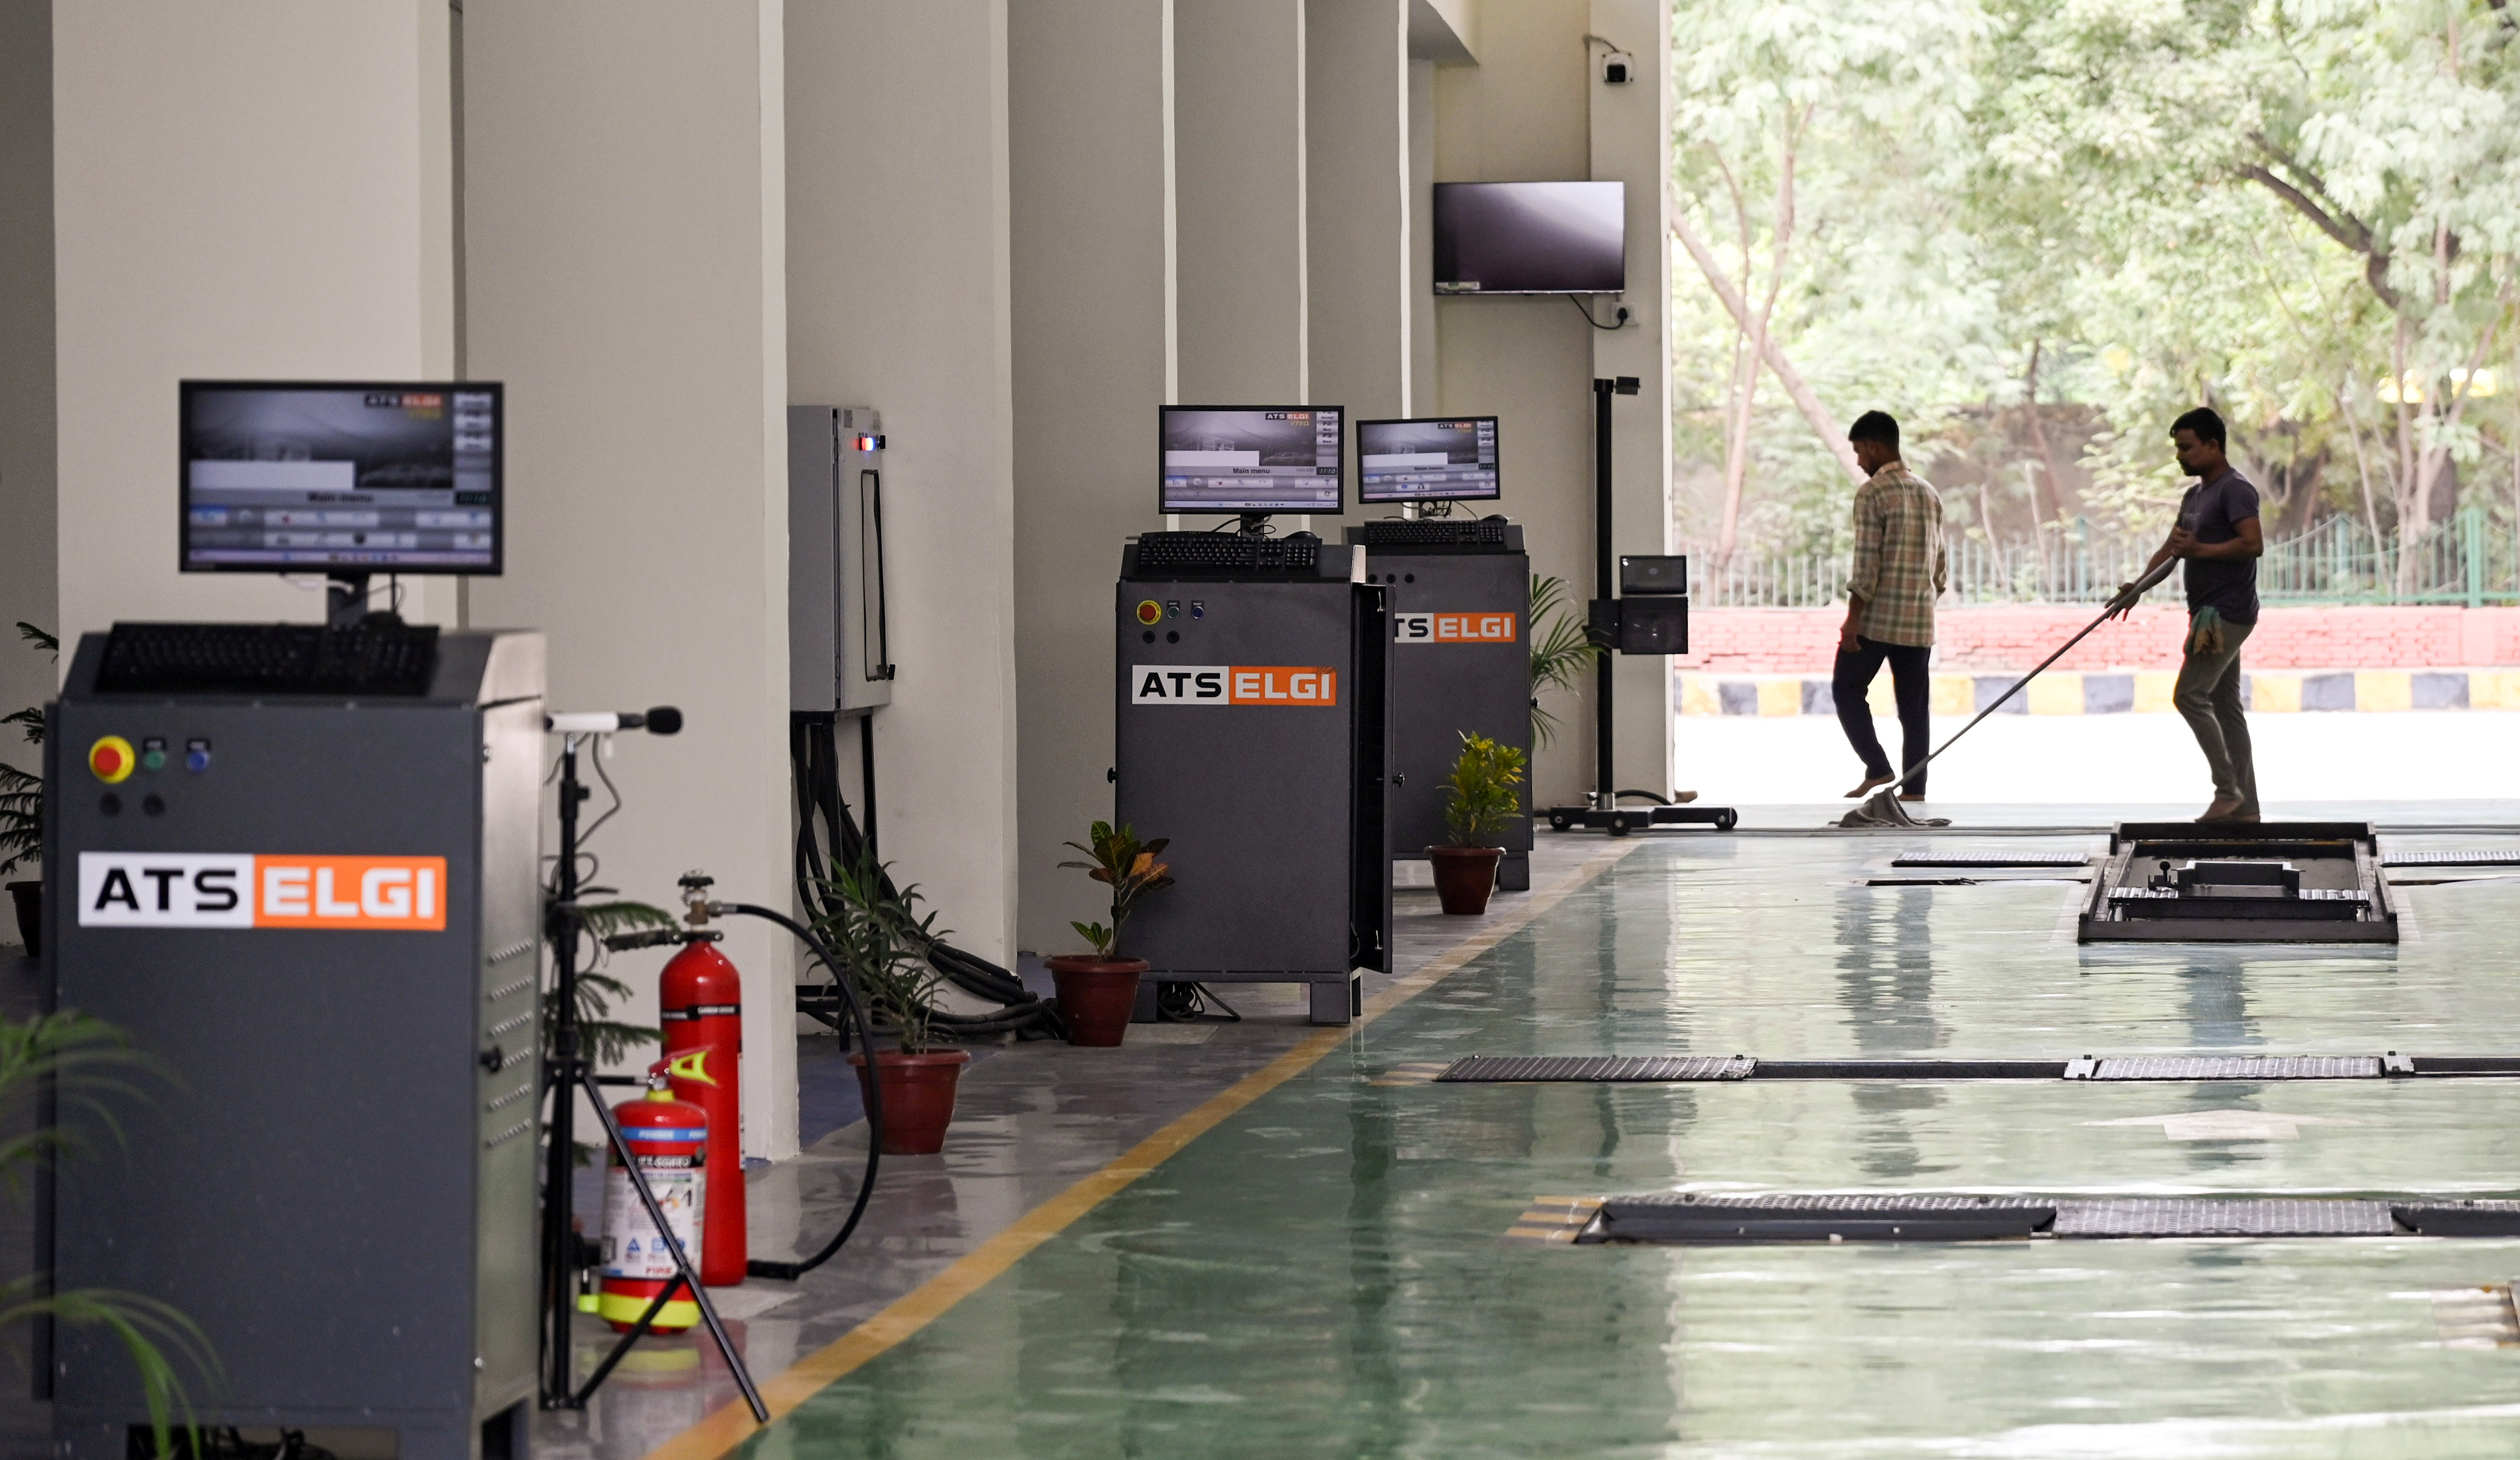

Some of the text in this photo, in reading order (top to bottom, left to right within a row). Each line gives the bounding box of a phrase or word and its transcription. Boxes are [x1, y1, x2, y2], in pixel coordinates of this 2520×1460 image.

[1395, 617, 1511, 638] TS ELGI
[1139, 672, 1330, 699] ATS ELGI
[94, 866, 435, 919] ATS ELGI
